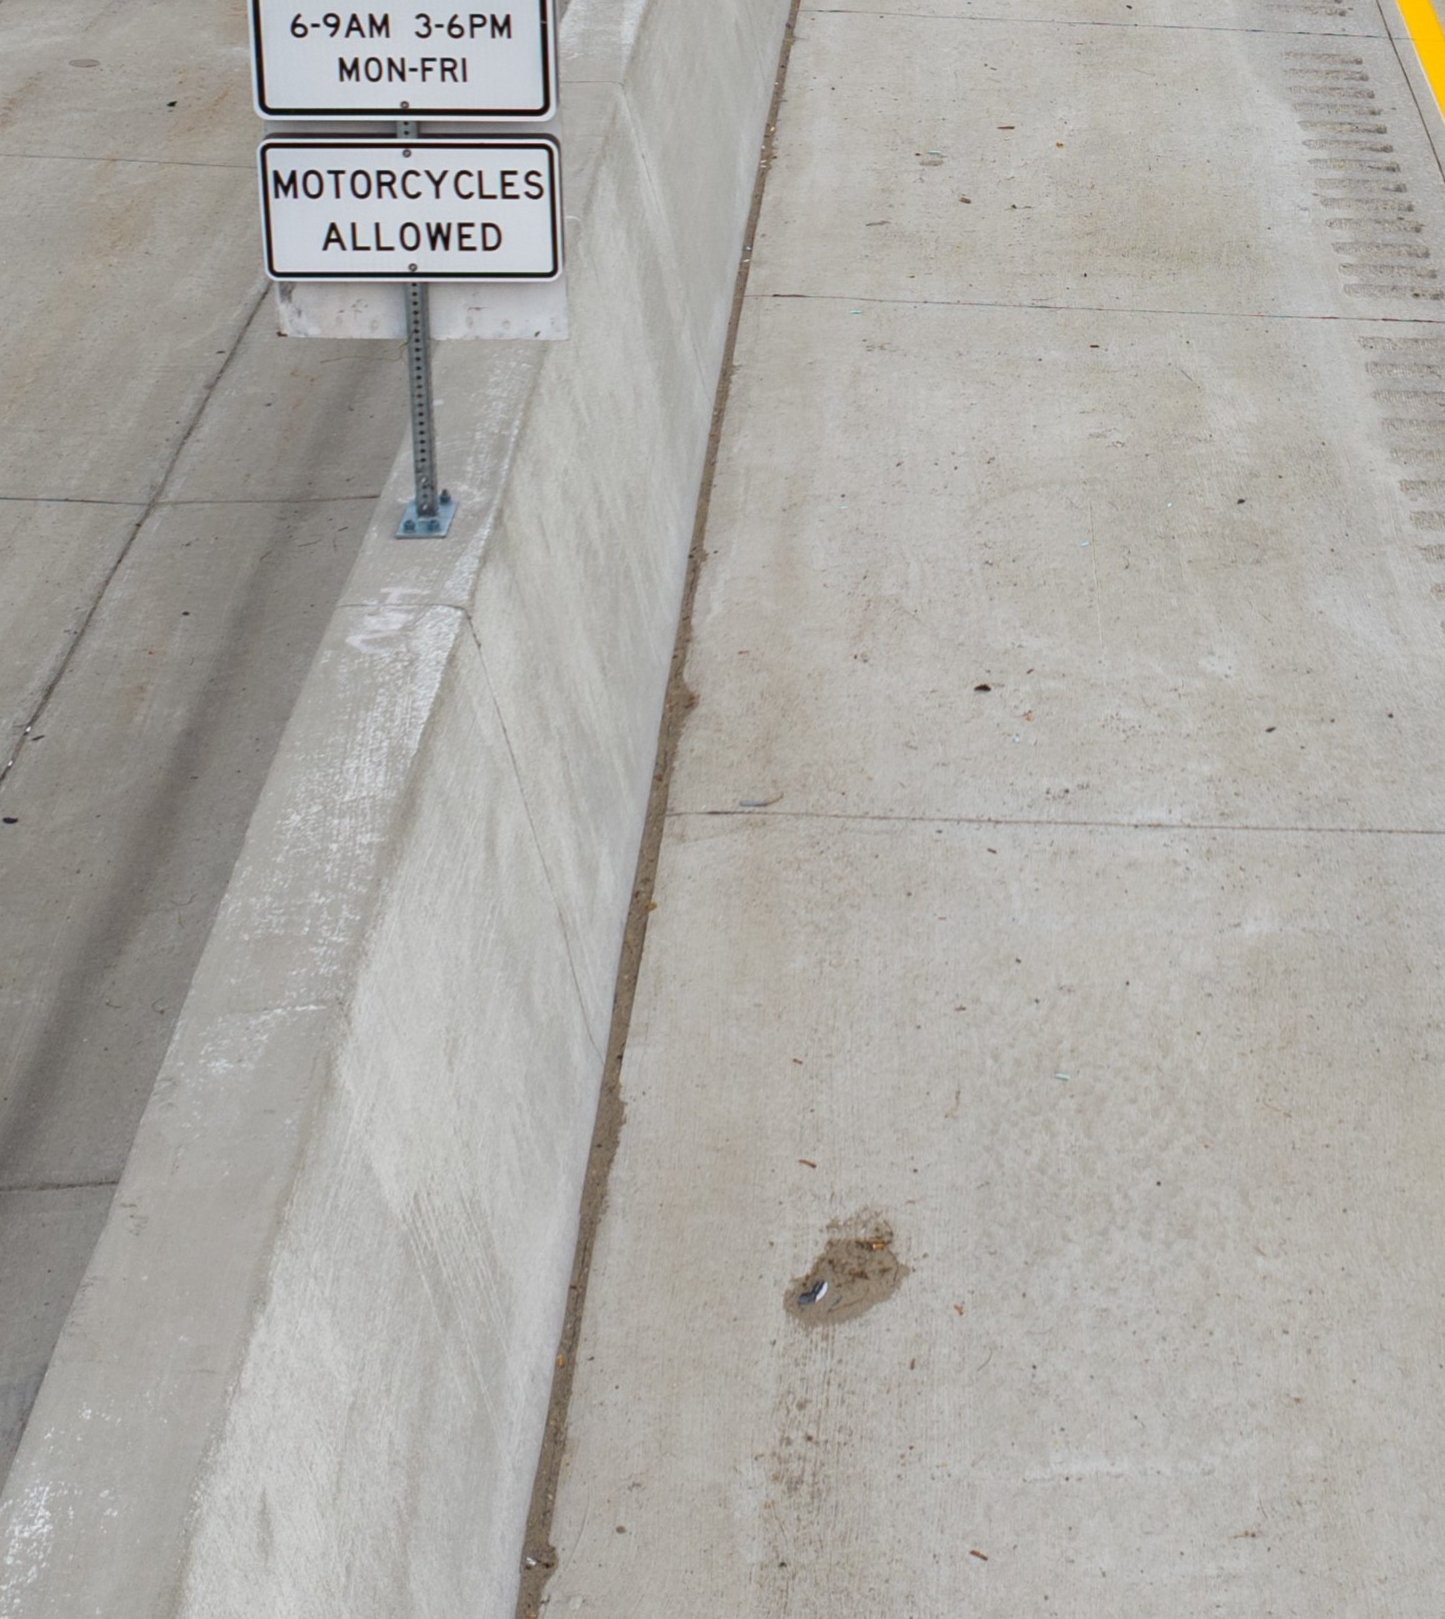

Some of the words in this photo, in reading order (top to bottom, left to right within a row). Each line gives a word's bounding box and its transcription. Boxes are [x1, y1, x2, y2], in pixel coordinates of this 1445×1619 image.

[289, 12, 390, 39] 6-9AM
[413, 13, 512, 40] 3-6PM
[338, 56, 468, 83] MON-FRI
[272, 168, 545, 200] MOTORCYCLES
[322, 221, 502, 252] ALLOWED
